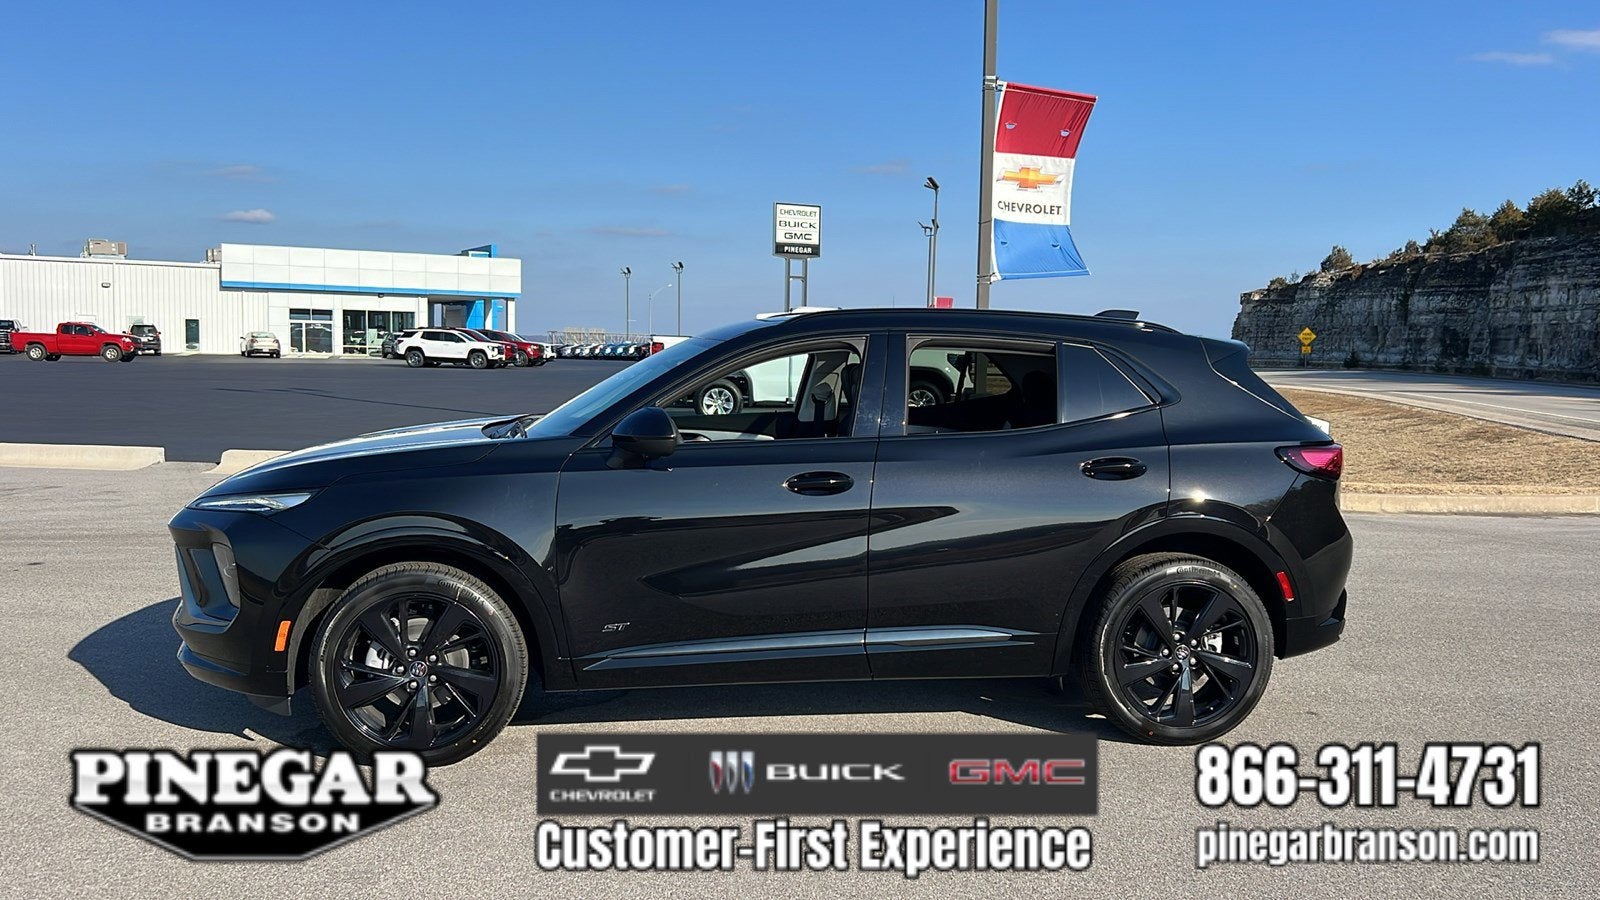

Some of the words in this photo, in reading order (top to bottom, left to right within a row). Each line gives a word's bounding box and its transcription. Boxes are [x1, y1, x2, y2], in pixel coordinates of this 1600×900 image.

[997, 201, 1062, 215] CHEVROLET
[779, 209, 817, 217] CHEVROLET
[779, 220, 817, 229] BUICK
[784, 232, 813, 240] GMC
[602, 622, 631, 632] ST
